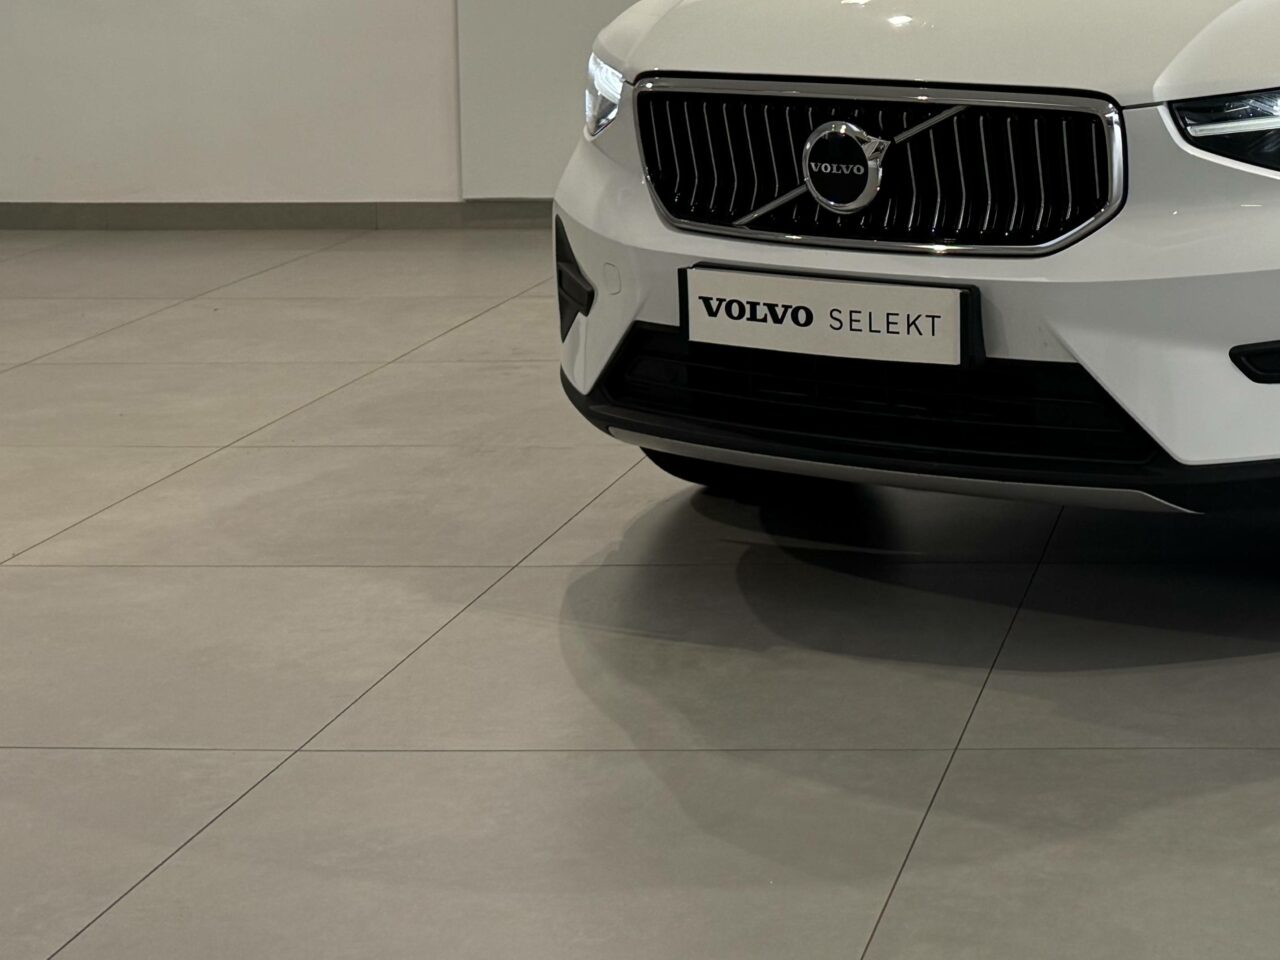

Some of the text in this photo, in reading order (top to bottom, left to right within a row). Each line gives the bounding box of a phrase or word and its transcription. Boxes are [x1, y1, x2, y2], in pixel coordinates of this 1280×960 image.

[810, 161, 865, 175] VOLVO
[698, 296, 941, 336] VOLVO SELEKT
